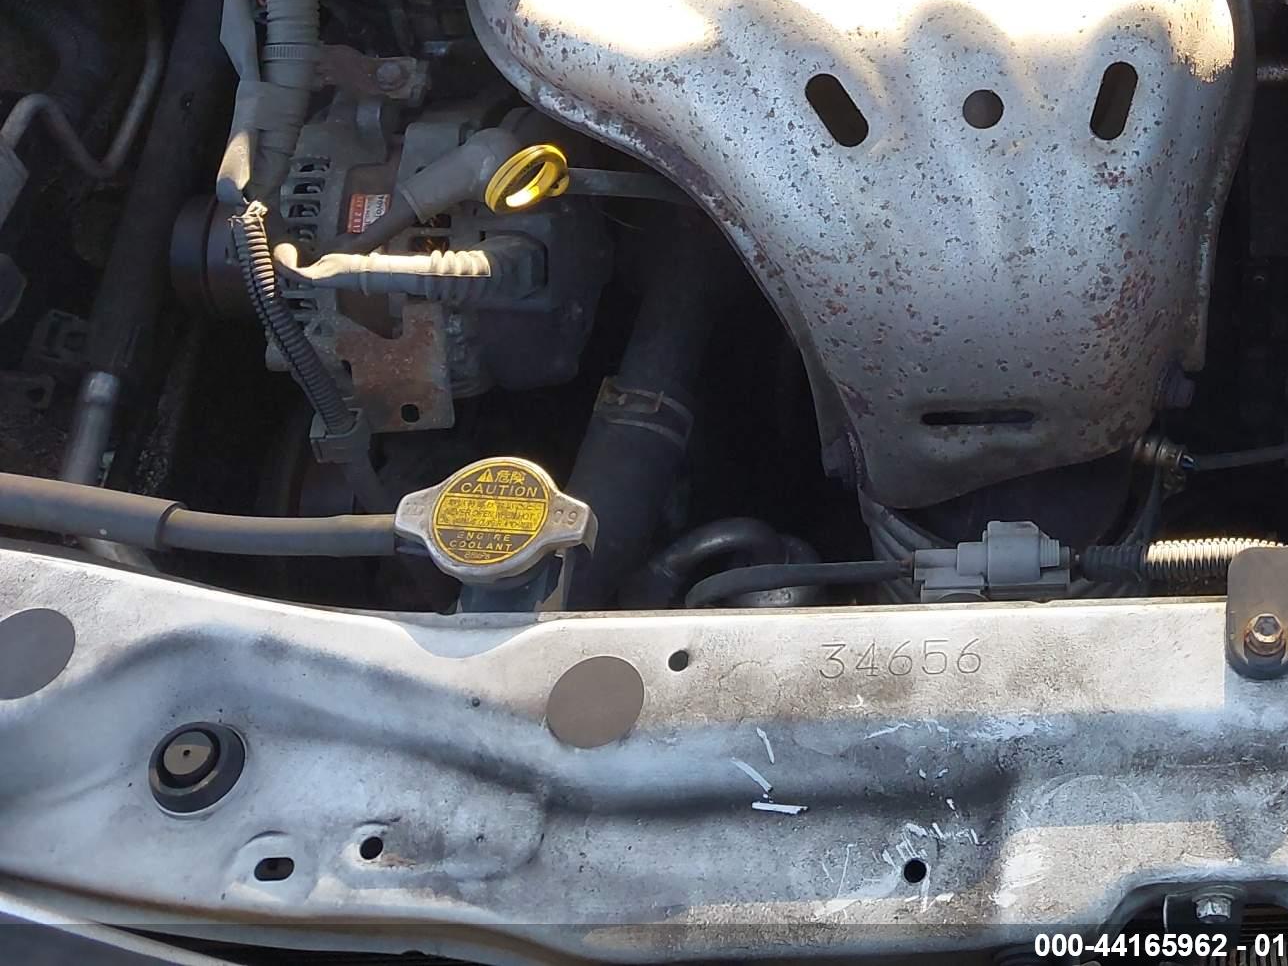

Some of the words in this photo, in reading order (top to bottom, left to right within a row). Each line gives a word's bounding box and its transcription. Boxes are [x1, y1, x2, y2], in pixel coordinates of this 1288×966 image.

[461, 483, 538, 498] CAUTION
[449, 540, 513, 551] COOLANT
[819, 638, 982, 679] 34656
